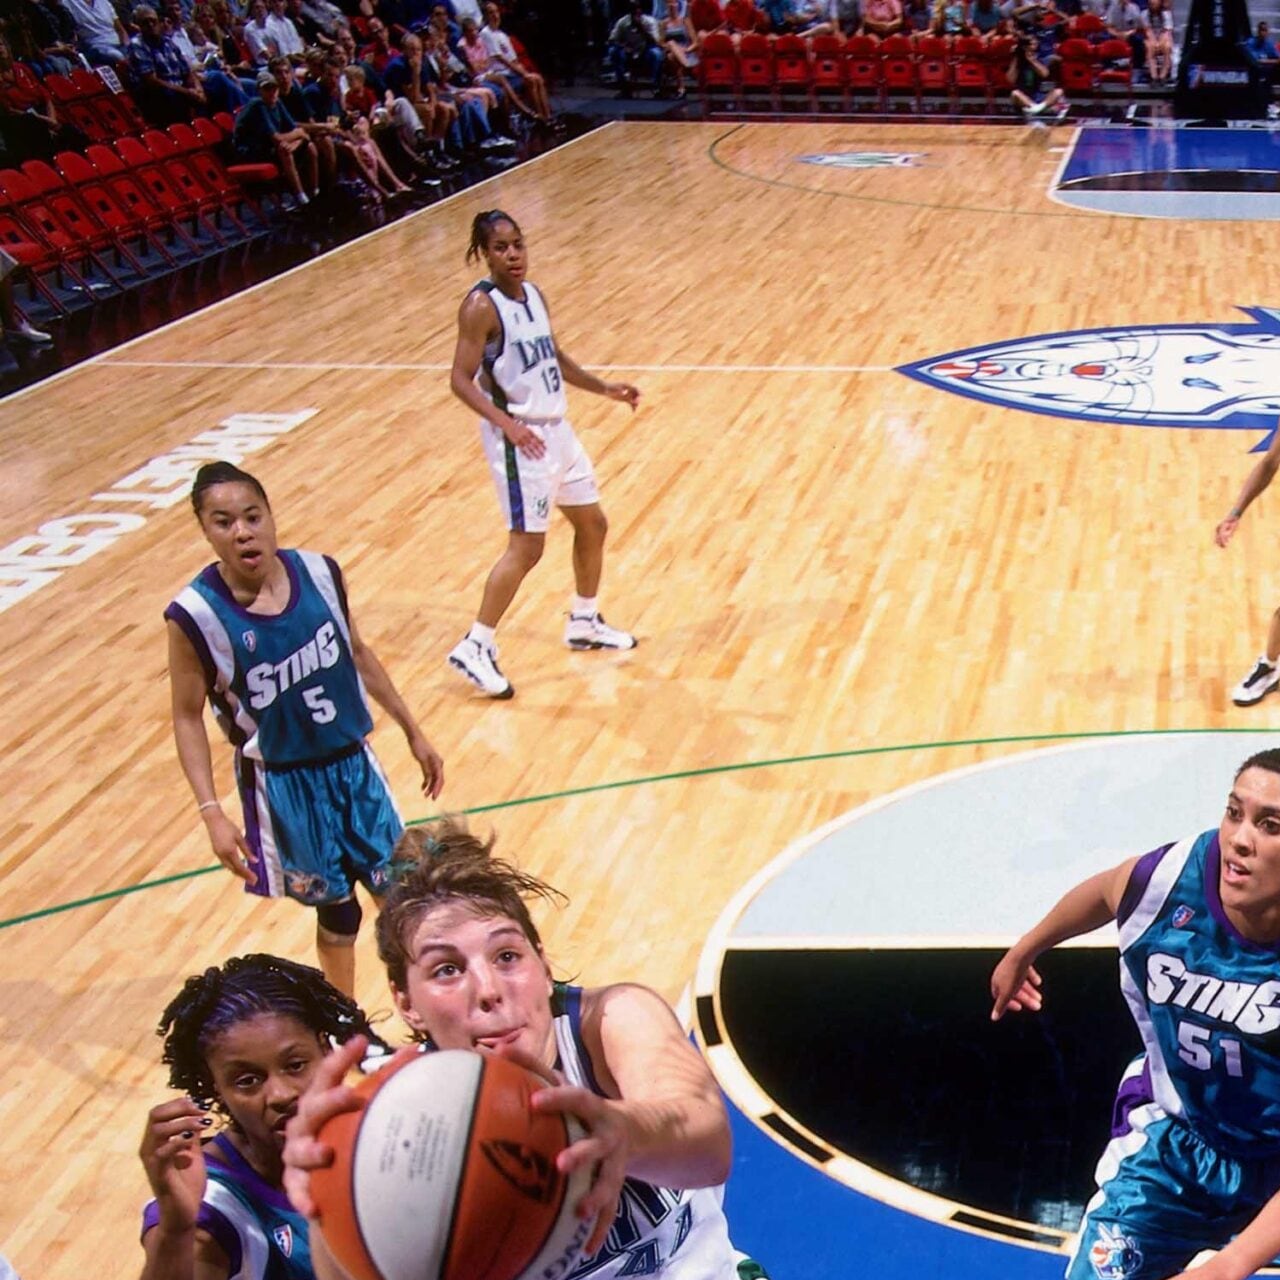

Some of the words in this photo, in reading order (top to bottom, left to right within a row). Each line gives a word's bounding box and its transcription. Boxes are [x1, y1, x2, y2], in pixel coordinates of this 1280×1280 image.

[540, 365, 560, 394] 13
[246, 620, 340, 711] STING
[302, 685, 338, 725] 5
[1178, 1020, 1243, 1078] 51
